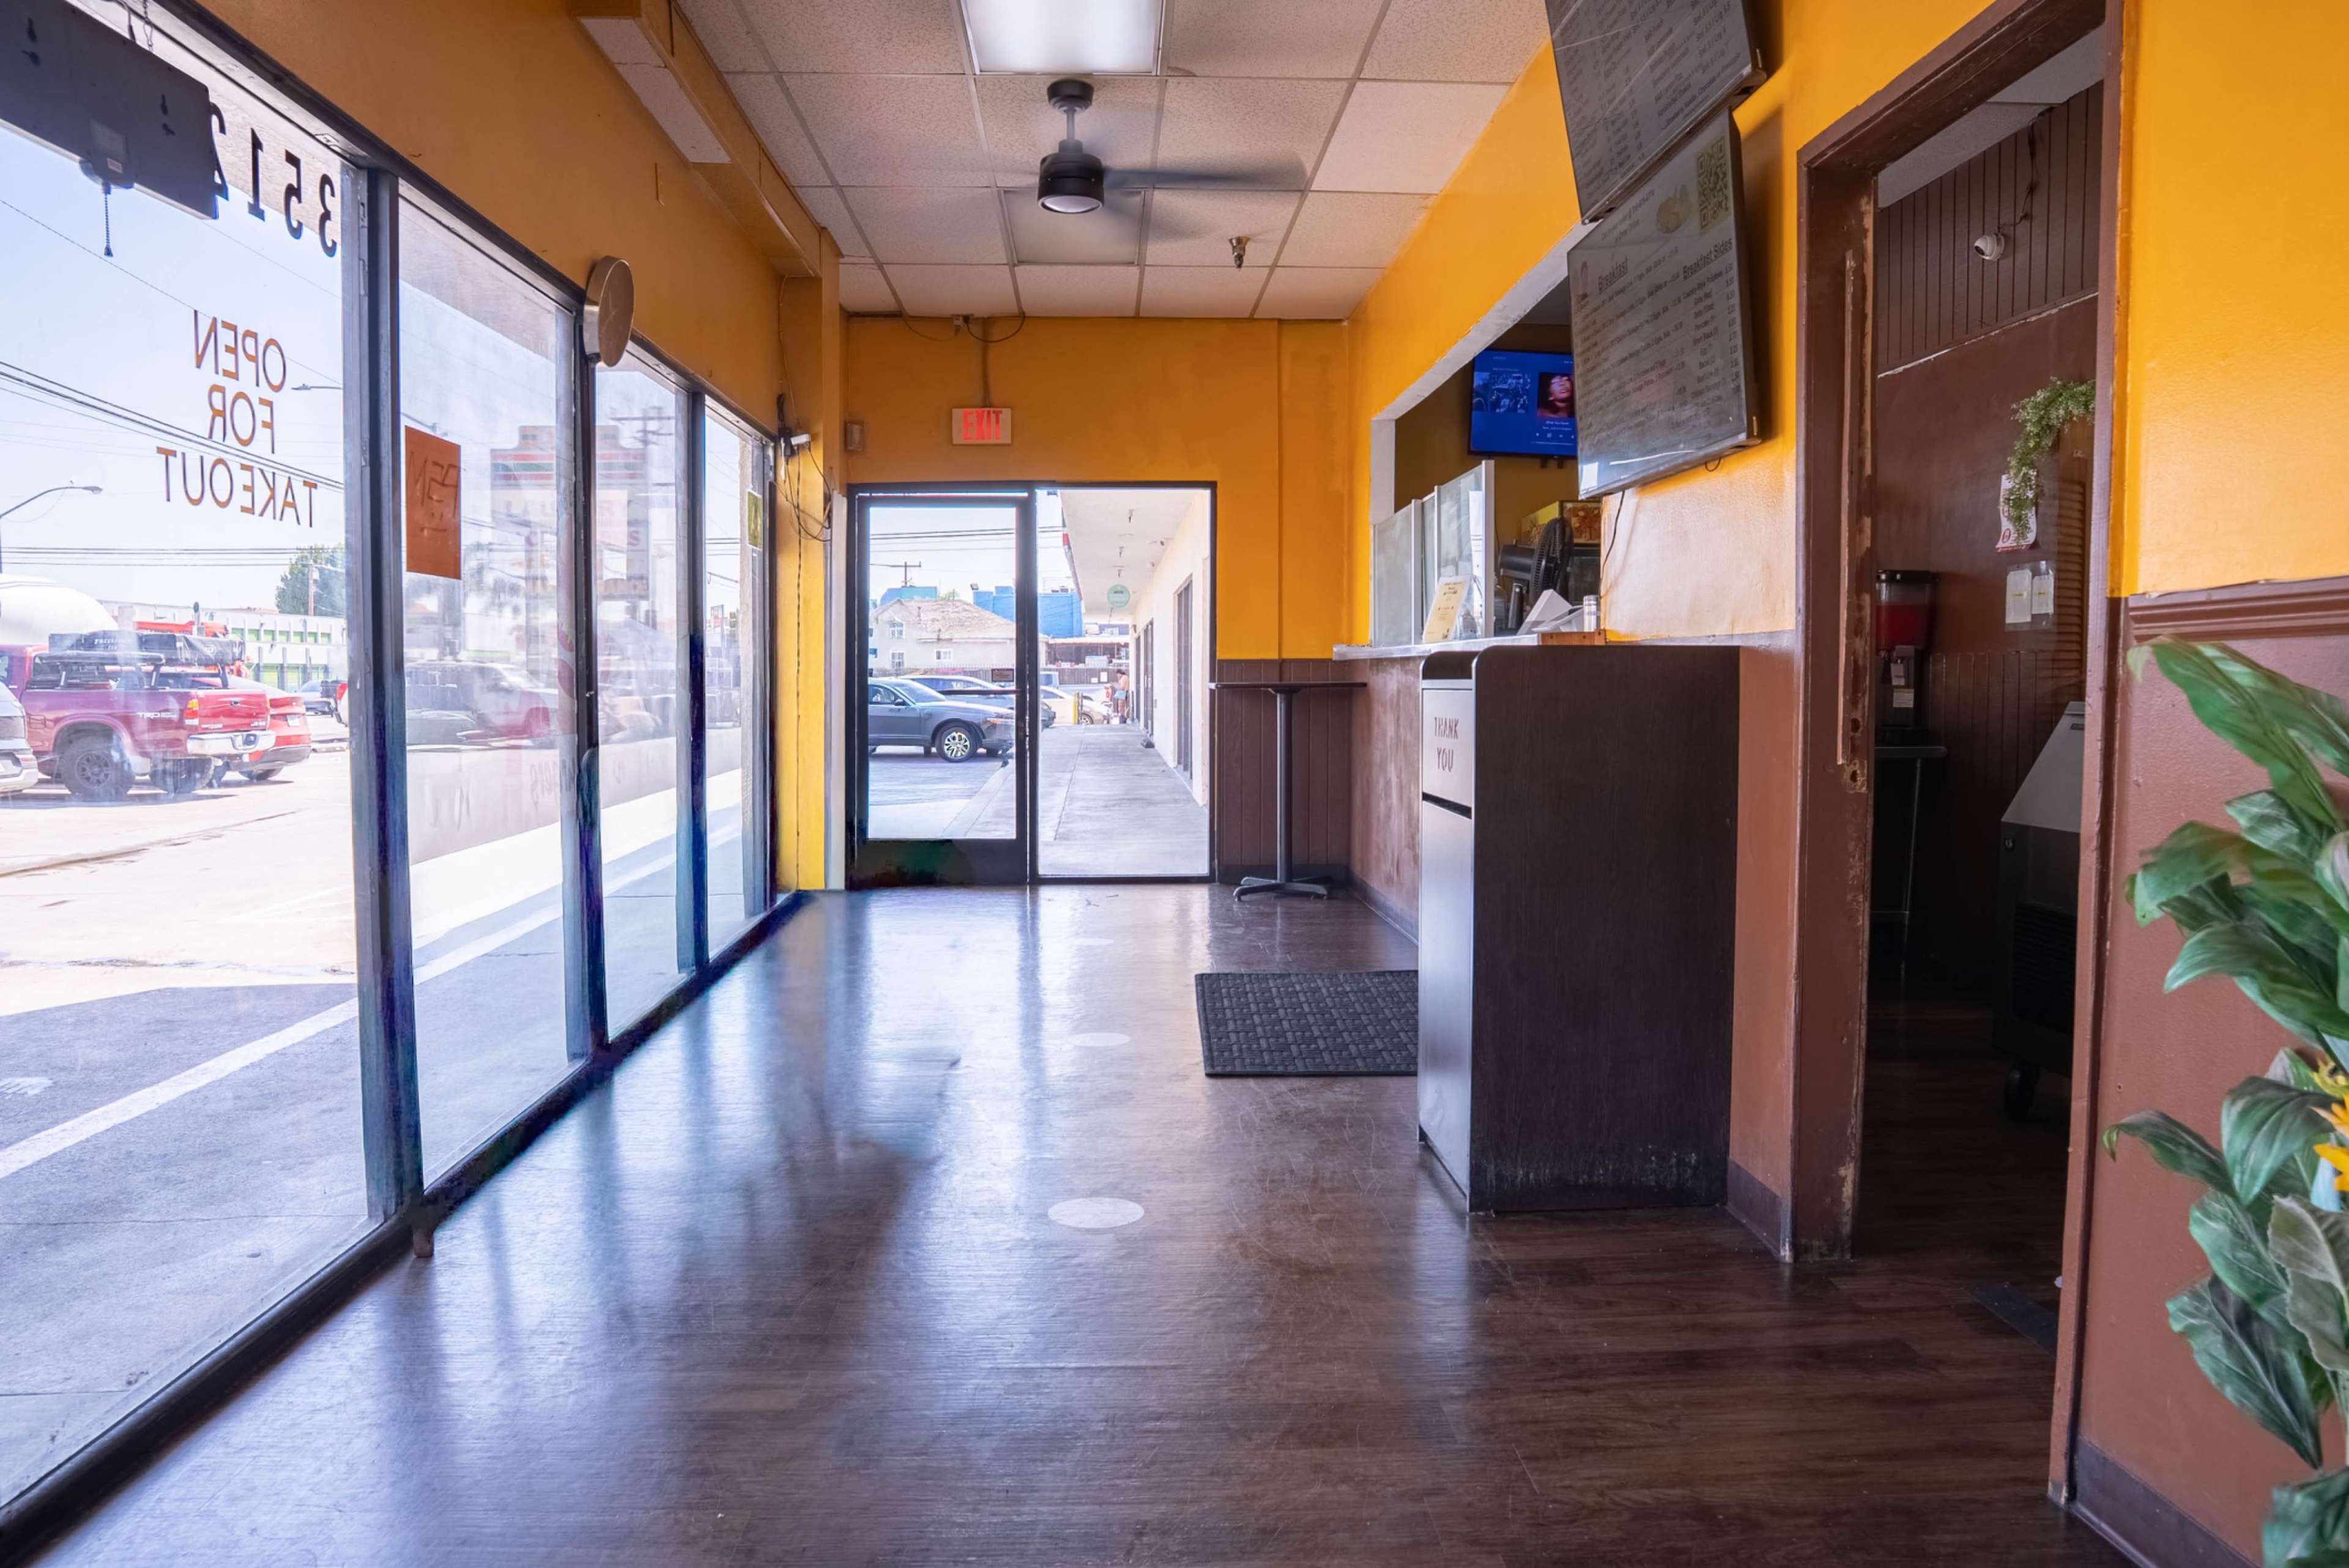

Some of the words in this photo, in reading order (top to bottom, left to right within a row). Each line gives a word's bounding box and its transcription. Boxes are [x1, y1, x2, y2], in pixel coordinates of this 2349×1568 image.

[1598, 257, 1628, 292] Breakfast
[1683, 254, 1713, 281] Breakfast
[1713, 239, 1732, 263] Sides
[962, 409, 1003, 440] EXIT
[1434, 717, 1459, 739] THANK
[1437, 747, 1454, 773] YOU
